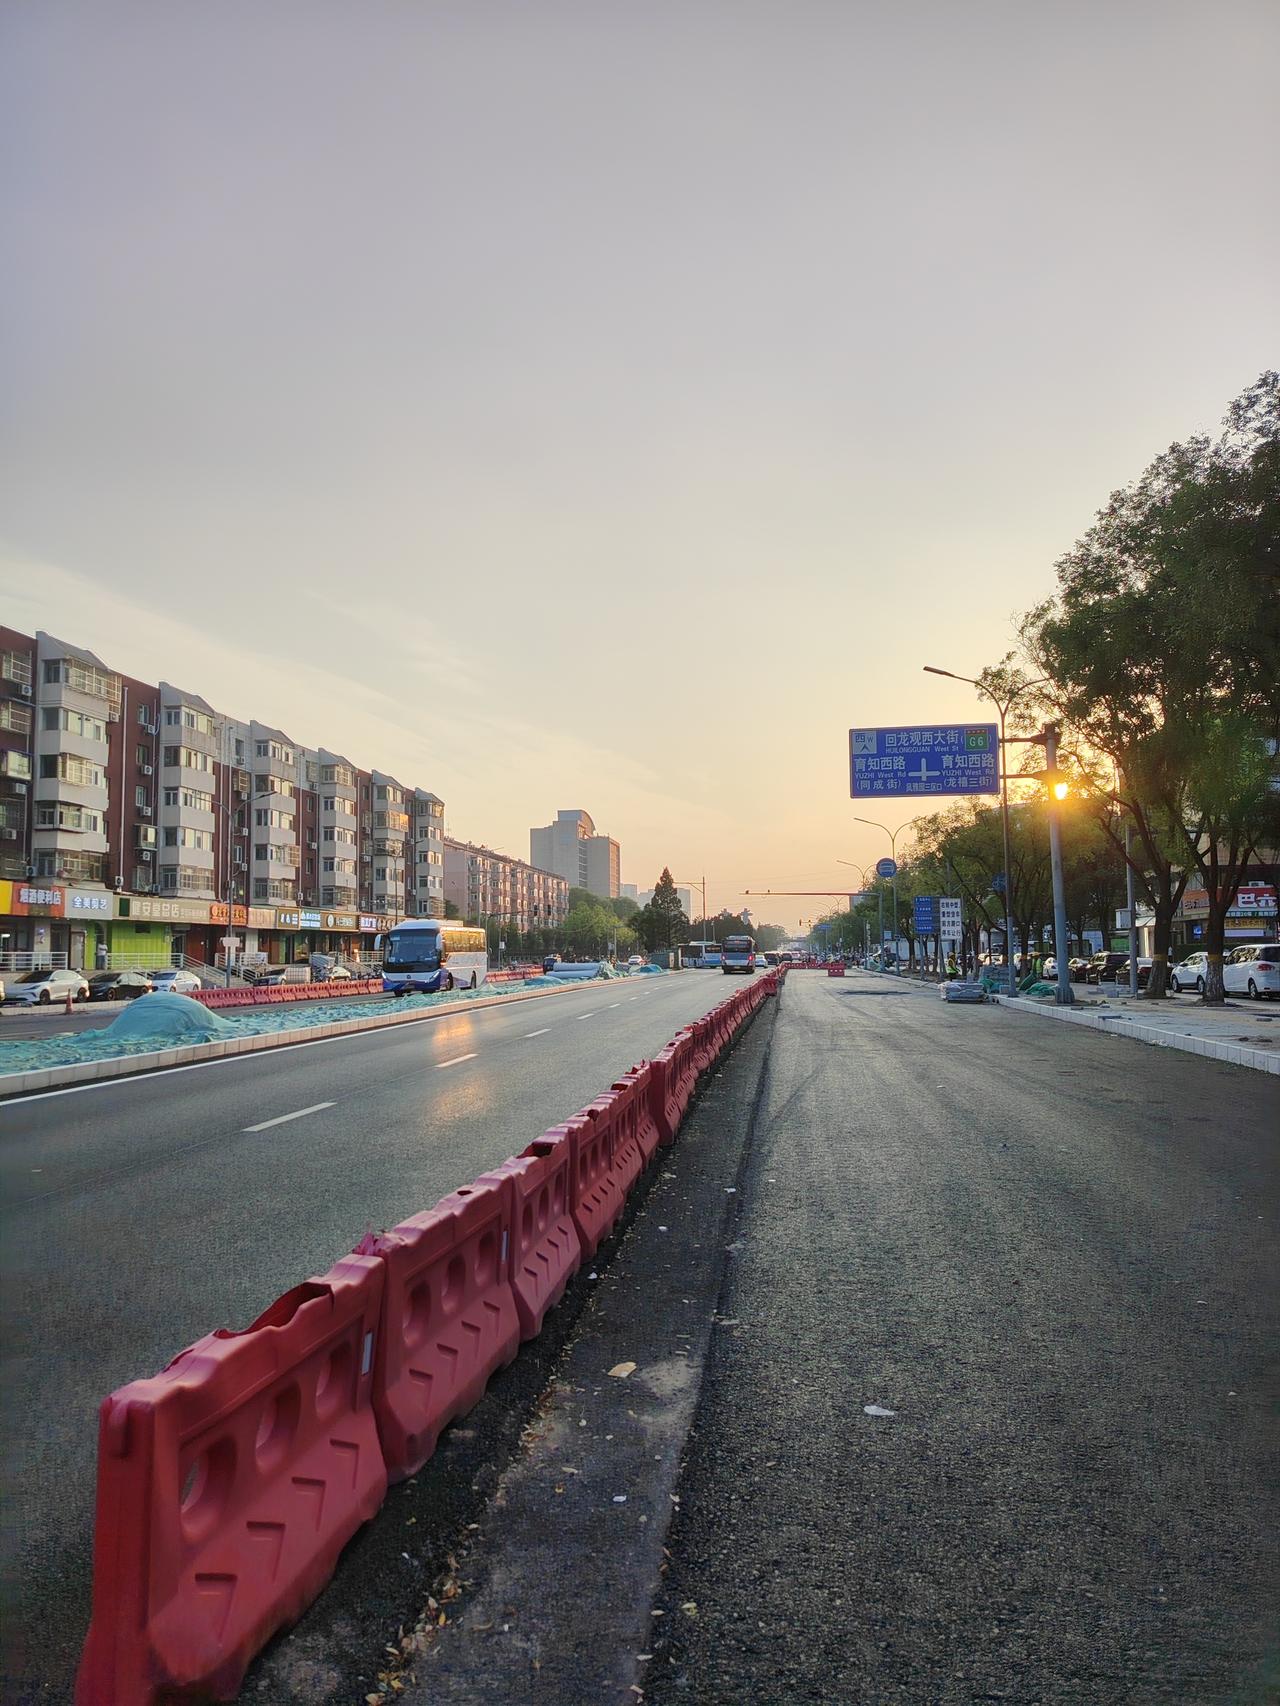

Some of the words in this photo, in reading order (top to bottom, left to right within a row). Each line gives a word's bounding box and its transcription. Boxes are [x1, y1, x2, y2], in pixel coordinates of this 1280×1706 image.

[885, 729, 959, 746] 回龙观西大街
[885, 746, 931, 754] HUILONGGUAN
[854, 755, 906, 772] 育知西路
[941, 753, 995, 769] 育知西路
[854, 772, 875, 780] YUZHI
[877, 771, 894, 779] West
[941, 769, 962, 777] YUZHI
[19, 887, 62, 905] 烟酒便利店
